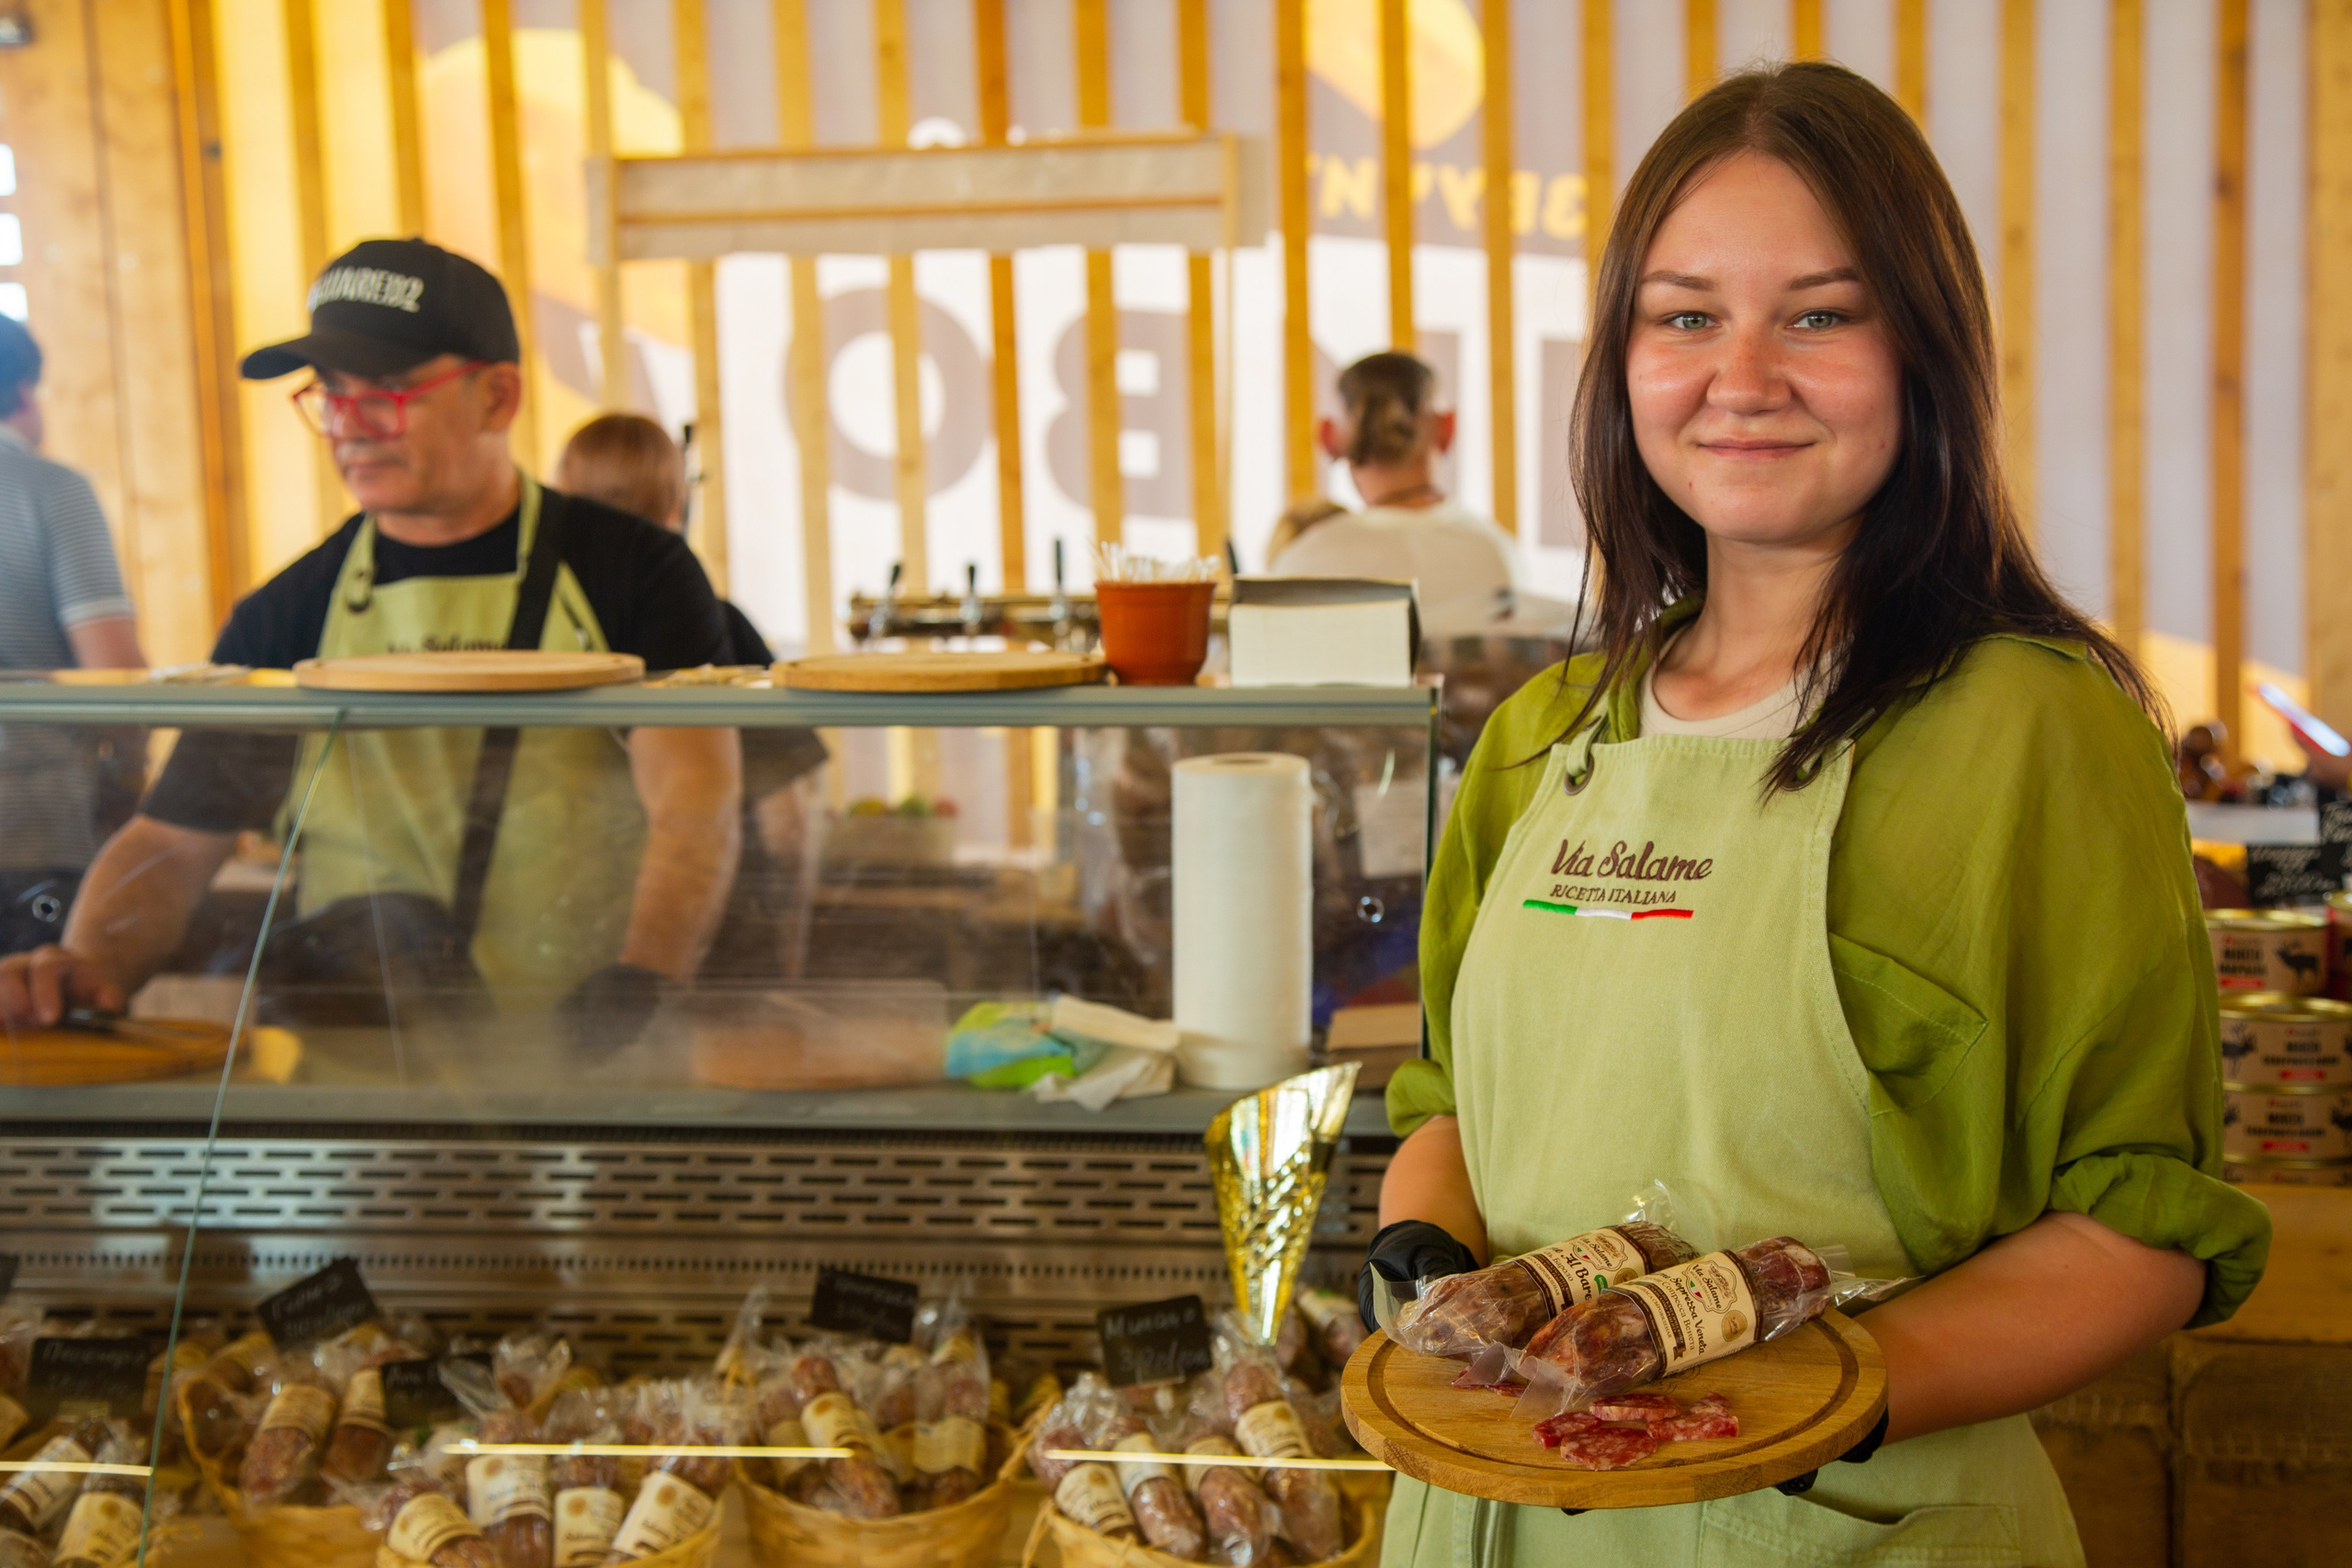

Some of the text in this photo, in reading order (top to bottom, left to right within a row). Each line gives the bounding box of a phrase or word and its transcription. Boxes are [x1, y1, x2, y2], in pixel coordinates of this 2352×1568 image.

[1549, 838, 1713, 882] Via Salame
[1550, 884, 1678, 906] RICETTA ITALIANA
[1553, 1258, 1574, 1281] Бароло
[1589, 1243, 1612, 1268] Salame
[1575, 1267, 1593, 1301] Baro
[1692, 1264, 1722, 1309] Via Salame
[1662, 1281, 1695, 1350] Сопресса Венета
[1694, 1319, 1708, 1356] Veneta
